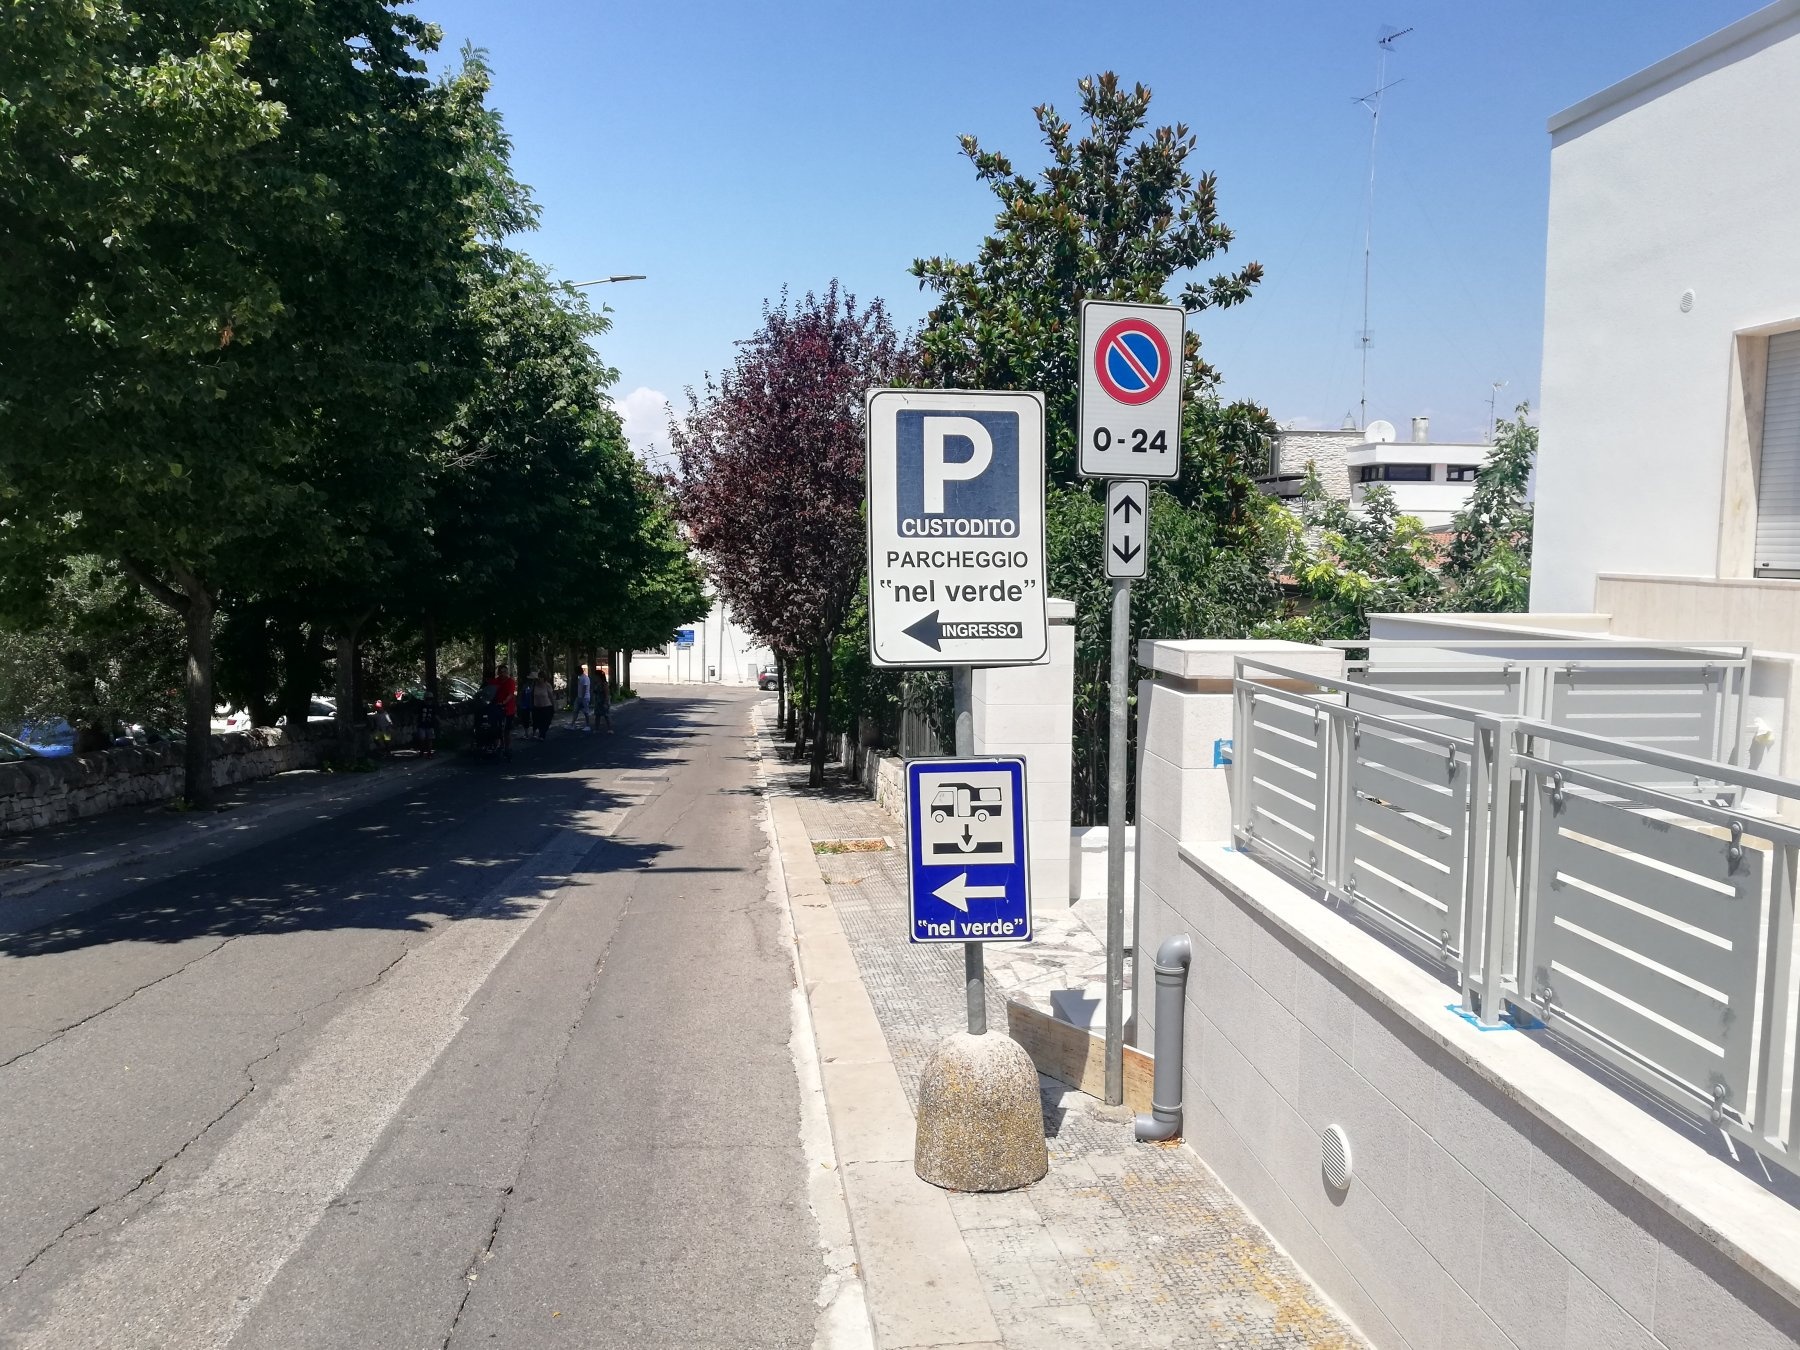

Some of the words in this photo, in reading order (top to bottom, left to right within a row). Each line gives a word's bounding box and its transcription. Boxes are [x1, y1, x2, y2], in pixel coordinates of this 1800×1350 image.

[924, 416, 993, 514] P
[901, 518, 1016, 536] CUSTODITO
[886, 551, 1028, 568] PARCHEGGIO
[942, 623, 1019, 638] INGRESSO
